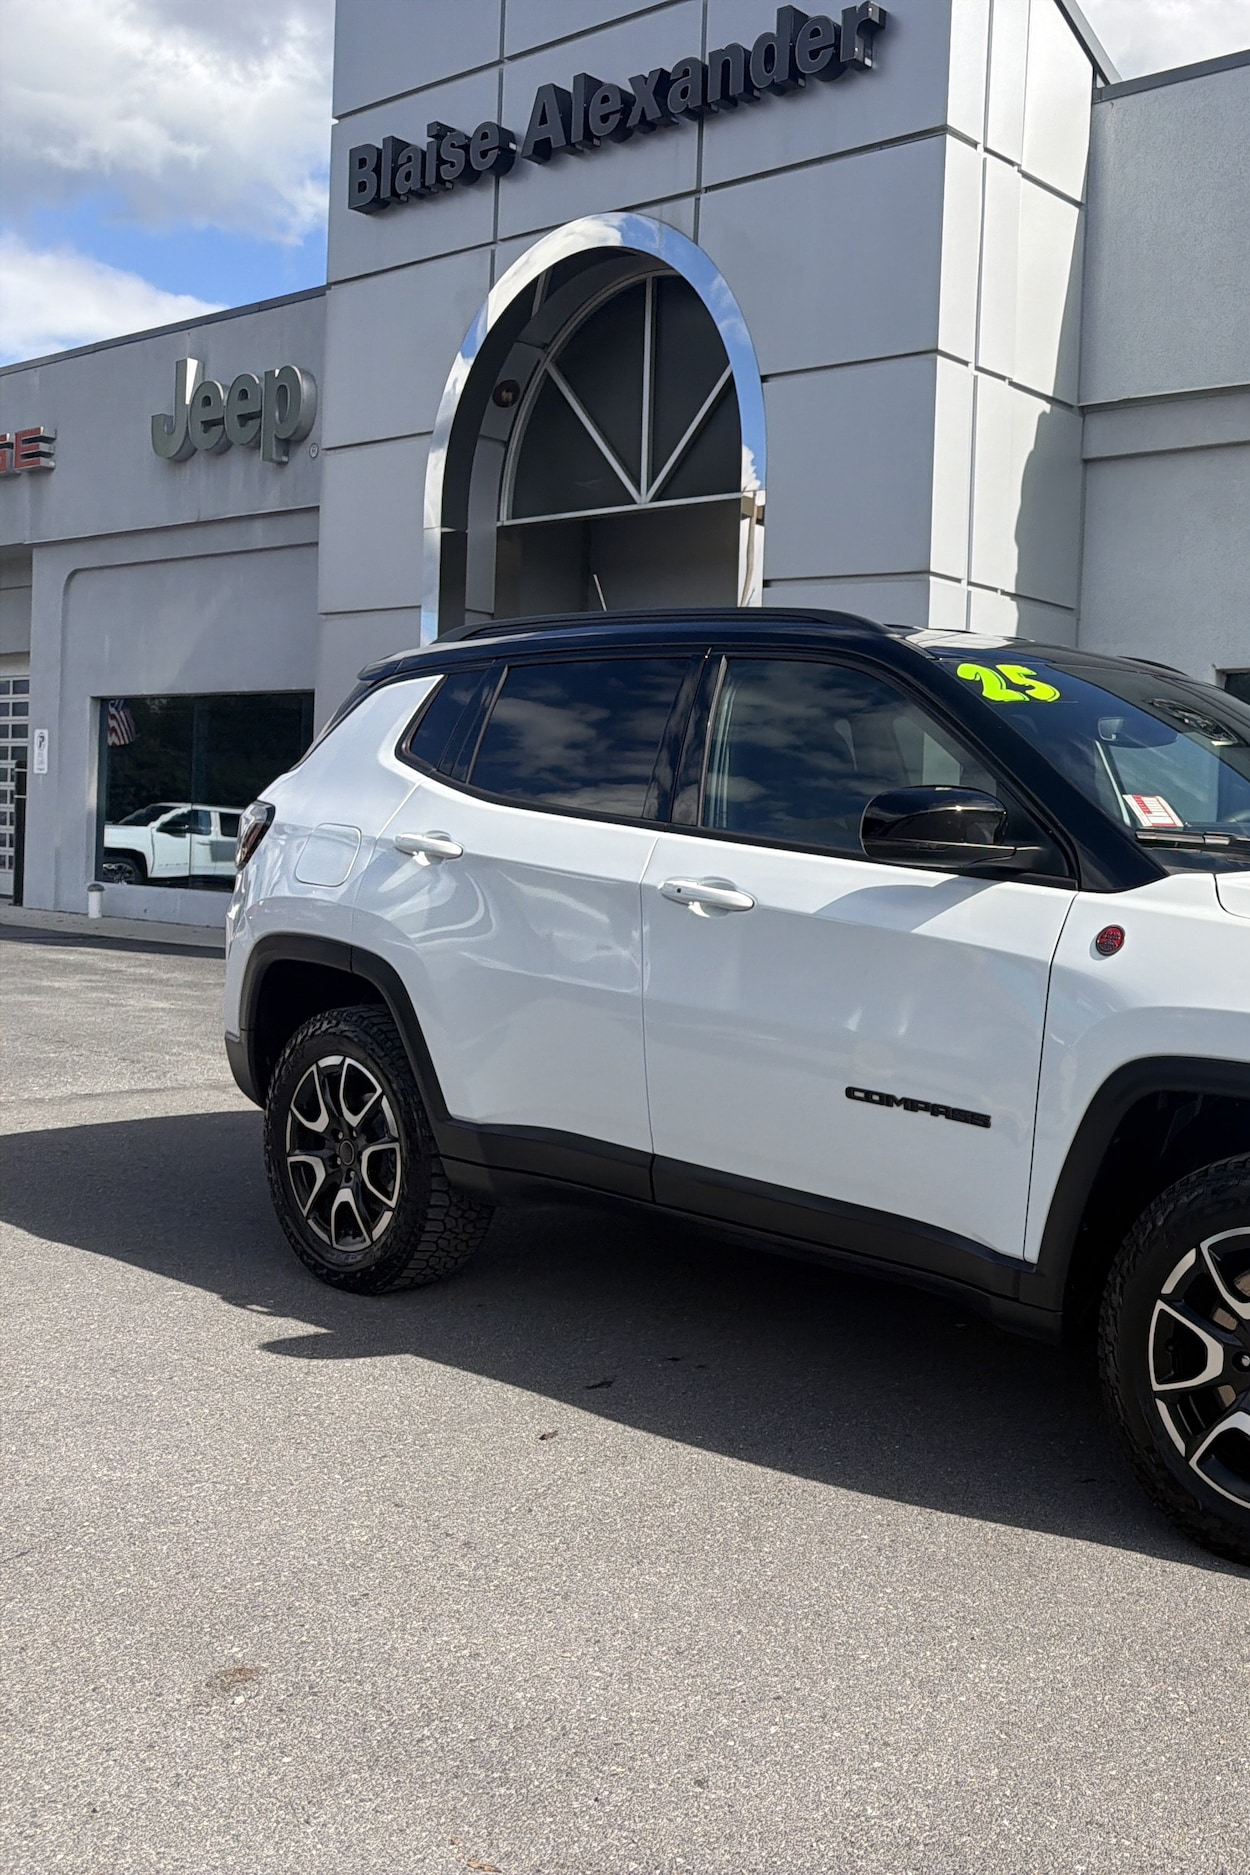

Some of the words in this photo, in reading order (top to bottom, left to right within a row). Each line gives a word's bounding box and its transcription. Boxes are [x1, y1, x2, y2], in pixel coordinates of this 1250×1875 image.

[348, 121, 514, 215] Blaise
[522, 1, 889, 164] Alexander
[151, 357, 317, 464] Jeep
[956, 663, 1061, 702] 25
[845, 1086, 991, 1128] COMPASS
